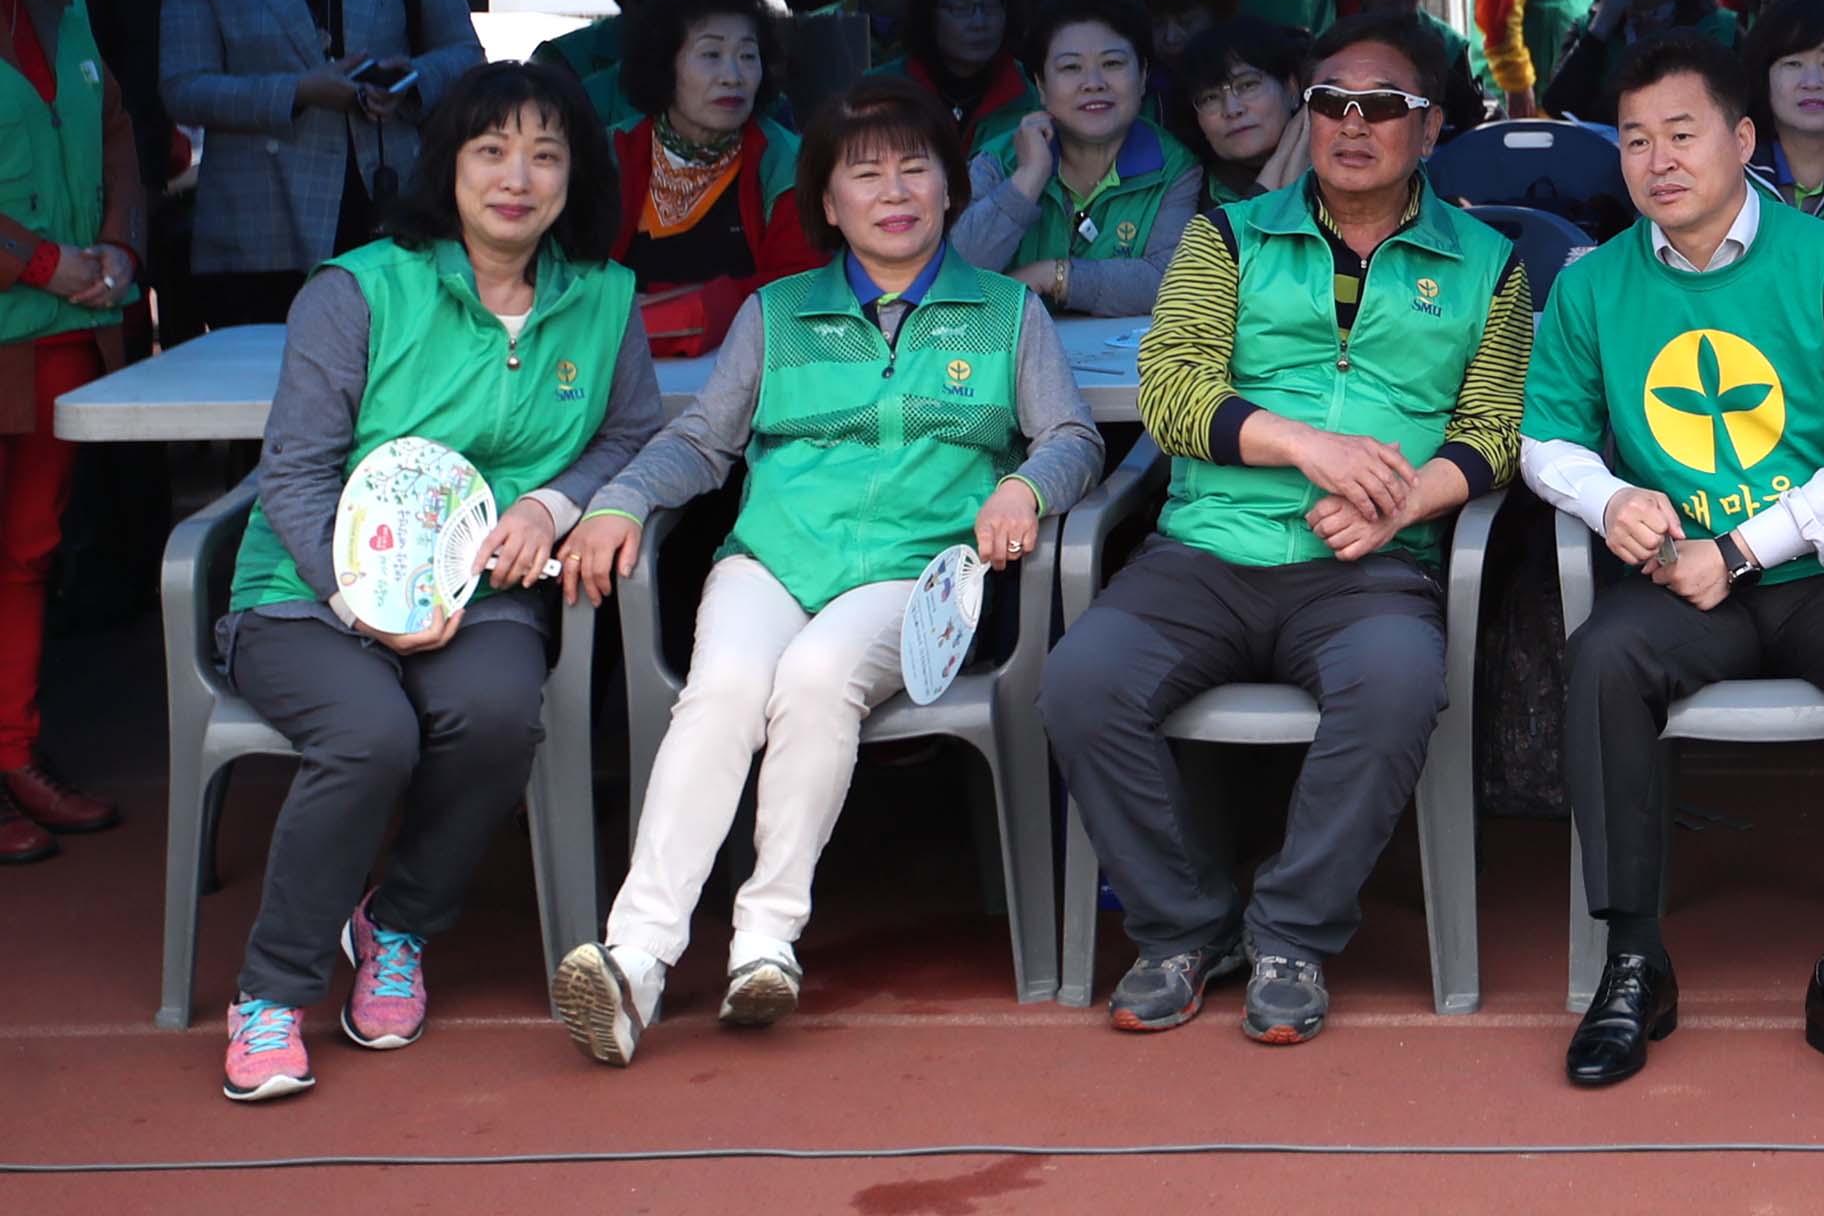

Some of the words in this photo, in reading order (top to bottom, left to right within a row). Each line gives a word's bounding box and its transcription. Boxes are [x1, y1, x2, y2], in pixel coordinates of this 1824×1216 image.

[1411, 298, 1442, 318] SMU
[555, 386, 585, 401] SMU
[942, 384, 975, 398] SMU
